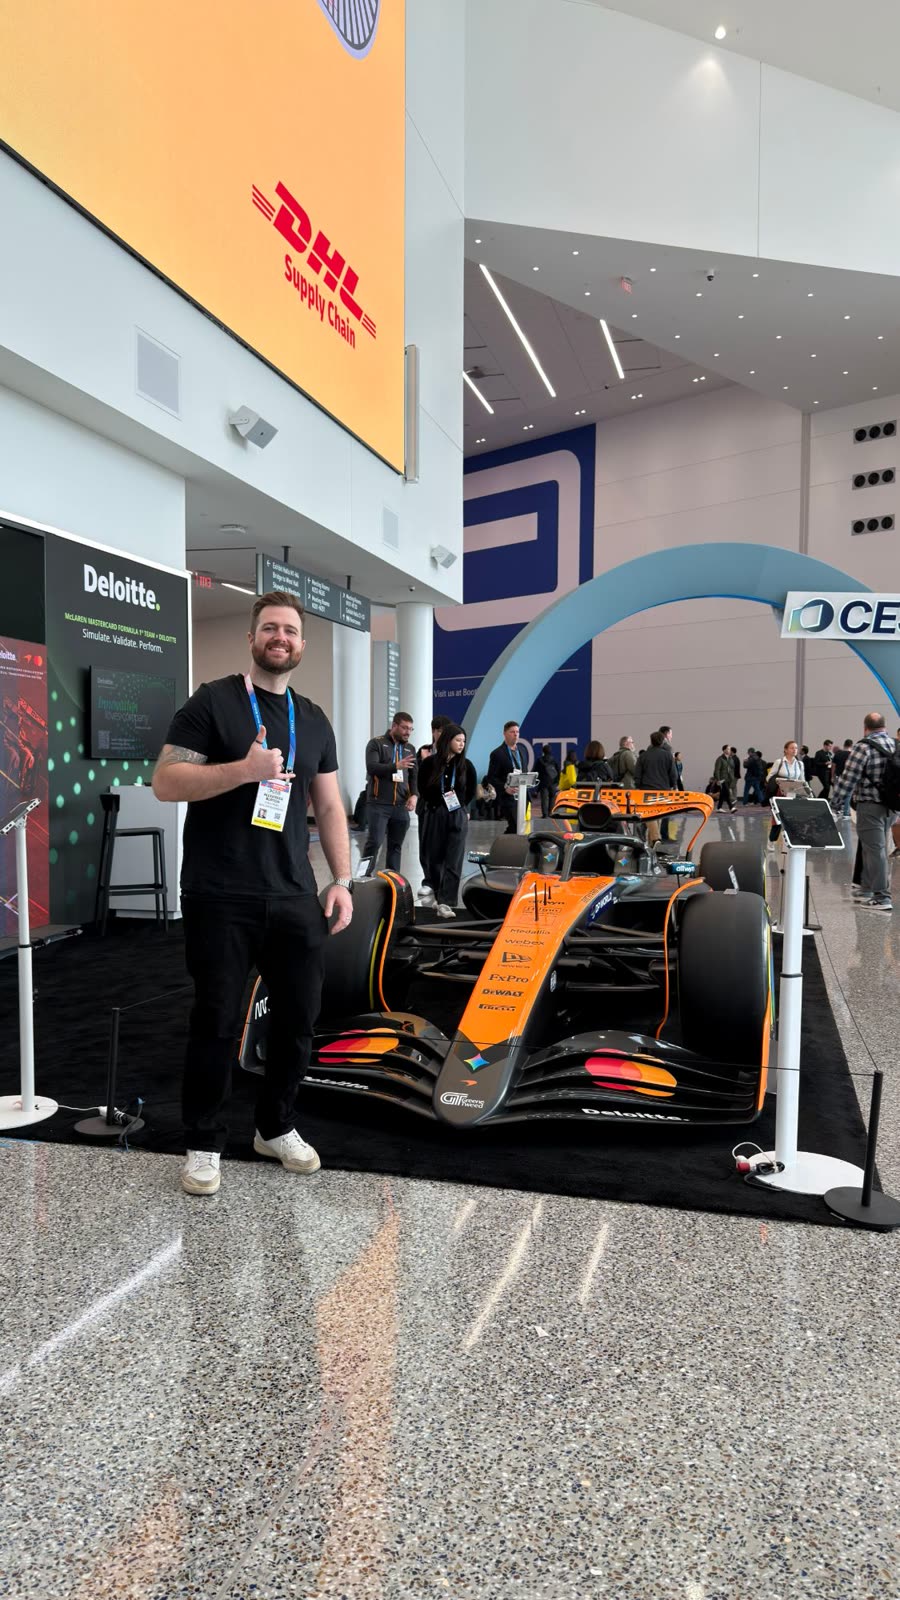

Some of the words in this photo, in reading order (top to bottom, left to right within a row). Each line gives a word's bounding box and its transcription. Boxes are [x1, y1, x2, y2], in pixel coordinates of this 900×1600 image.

[273, 180, 364, 322] DHL
[284, 253, 326, 322] Supply
[327, 301, 356, 350] Chain
[840, 600, 900, 634] CE
[82, 628, 112, 644] Simulate.
[112, 634, 139, 649] Validate.
[139, 640, 163, 654] Perform.
[434, 690, 447, 698] Visit
[455, 689, 462, 697] at
[488, 973, 529, 984] FxPro
